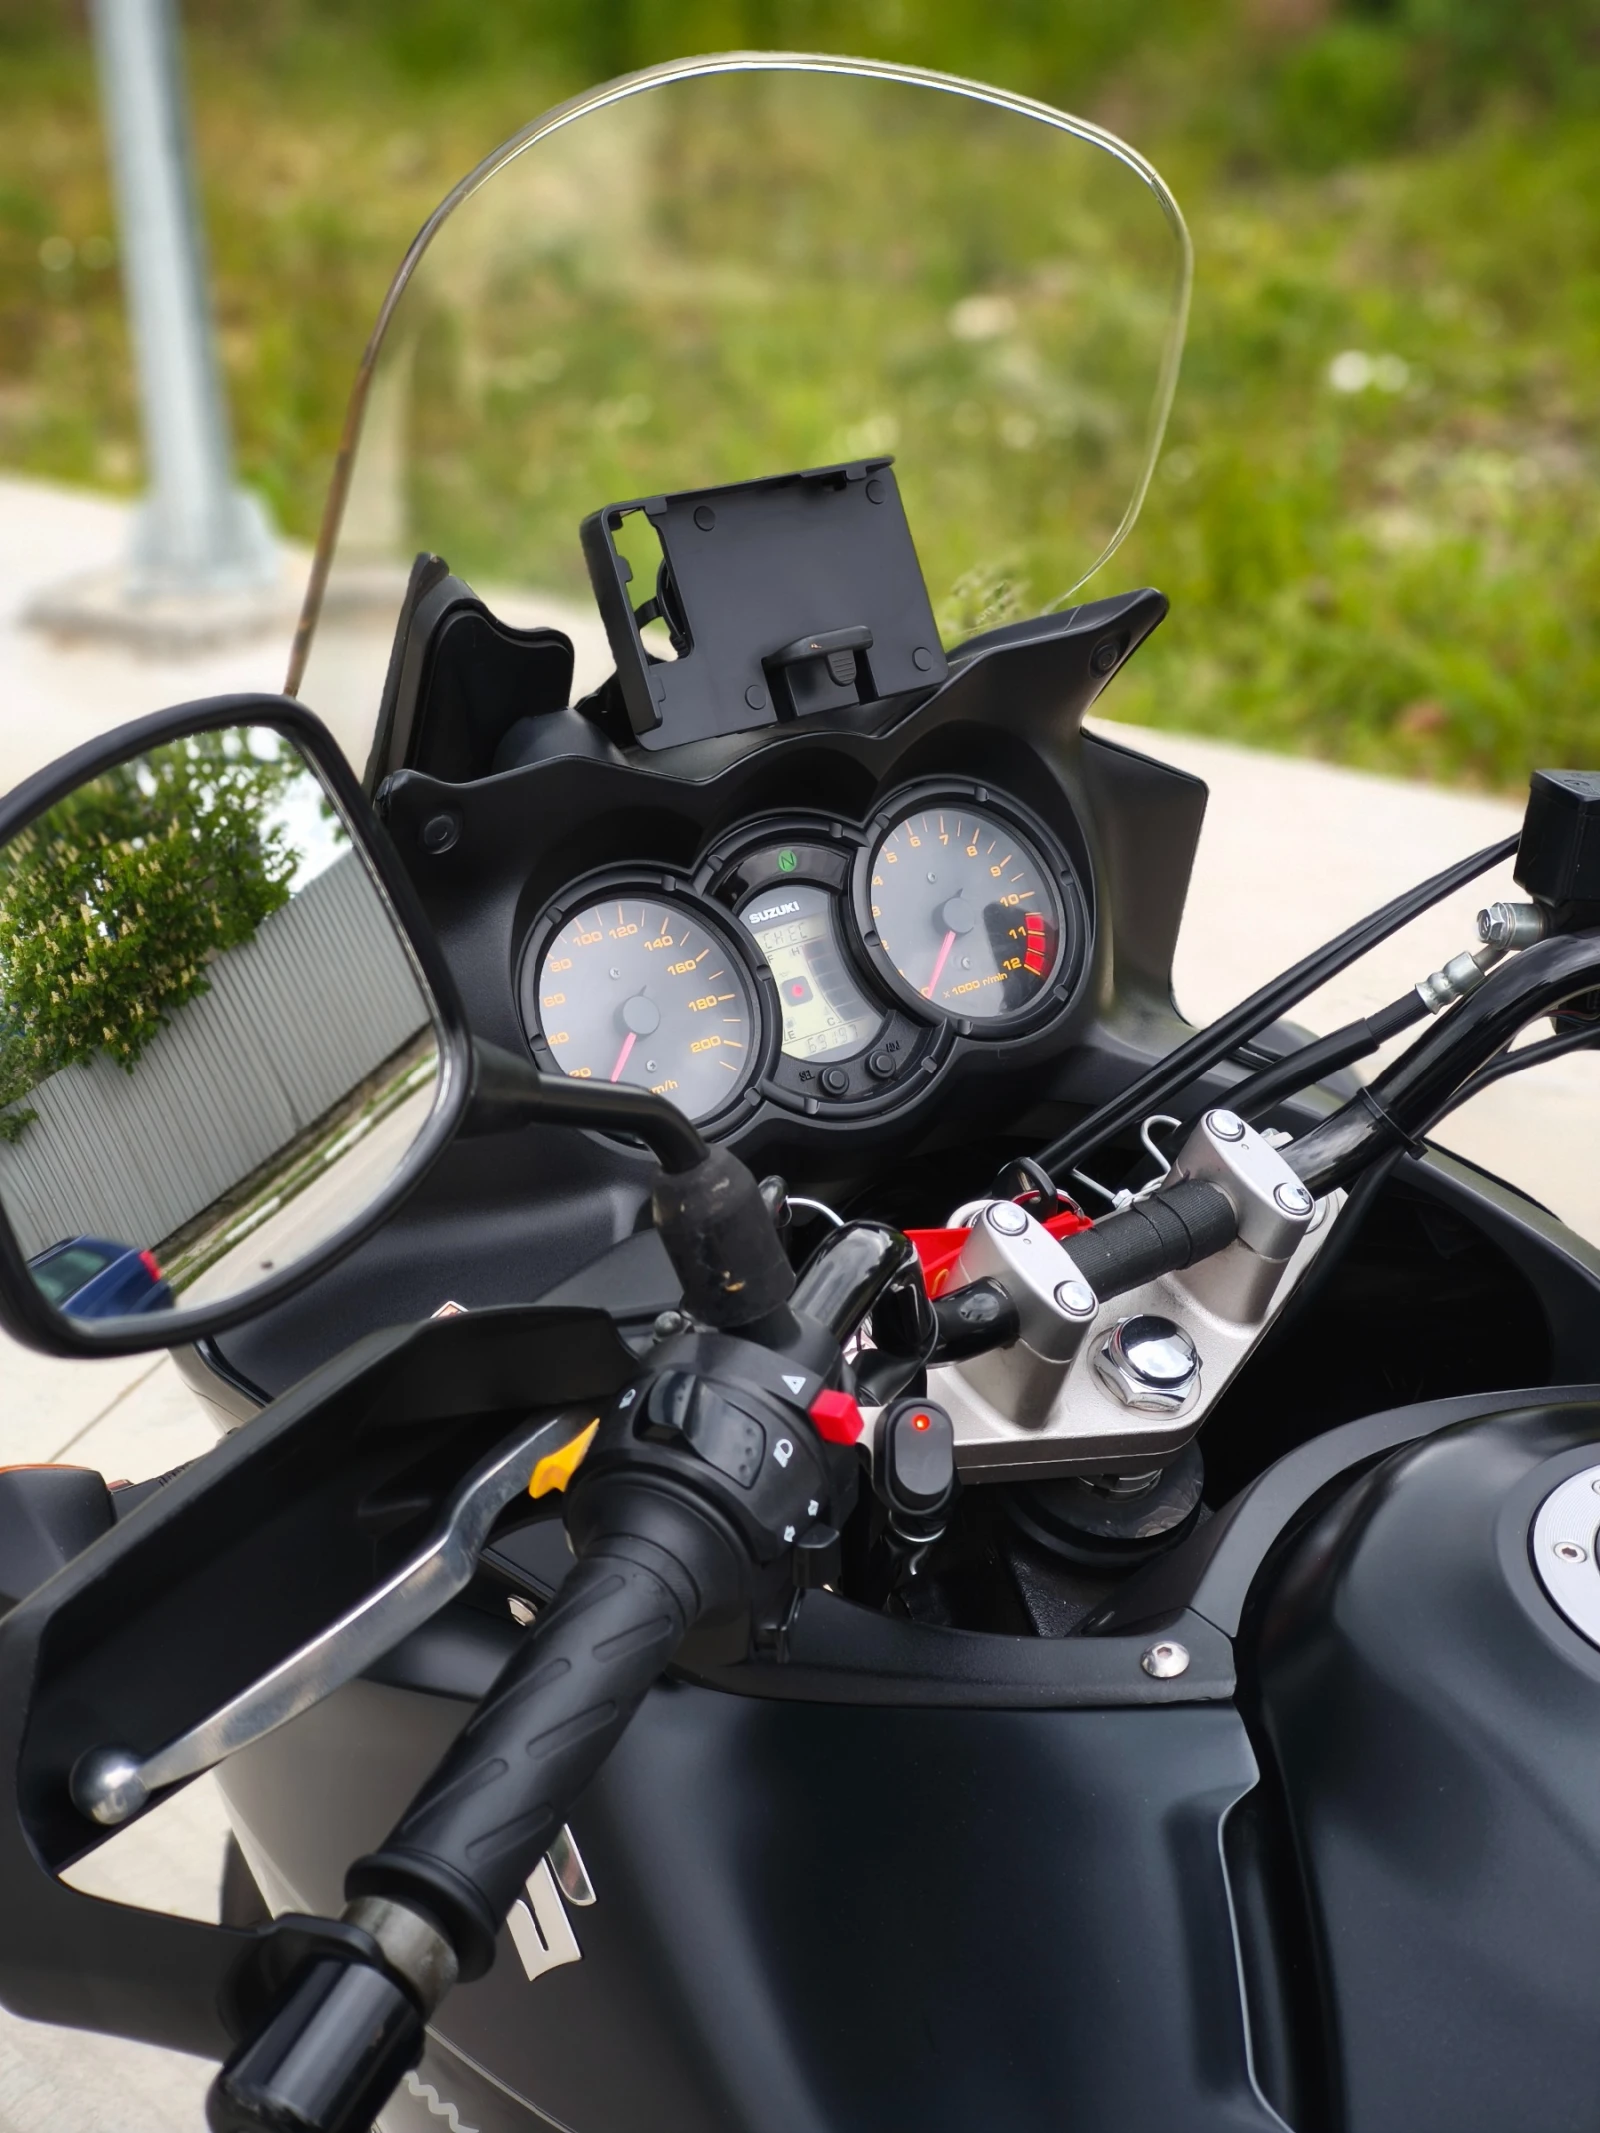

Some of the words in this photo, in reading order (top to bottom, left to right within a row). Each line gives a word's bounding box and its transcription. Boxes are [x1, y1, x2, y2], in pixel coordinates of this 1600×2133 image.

[909, 836, 922, 847] 6
[939, 834, 949, 845] 7
[886, 852, 898, 864] 5
[966, 845, 978, 857] 8
[780, 853, 795, 869] N
[990, 865, 1002, 878] 9
[1000, 893, 1019, 908] 10
[748, 900, 800, 924] SUZUKI
[573, 931, 603, 947] 100
[608, 923, 638, 940] 120
[1009, 926, 1027, 940] 11
[644, 935, 674, 951] 140
[550, 959, 572, 972] 80
[667, 959, 697, 976] 160
[1003, 957, 1022, 970] 12
[951, 980, 981, 996] 1000
[543, 993, 566, 1007] 60
[688, 995, 718, 1012] 180
[690, 1035, 721, 1053] 200
[651, 1079, 678, 1095] m/h
